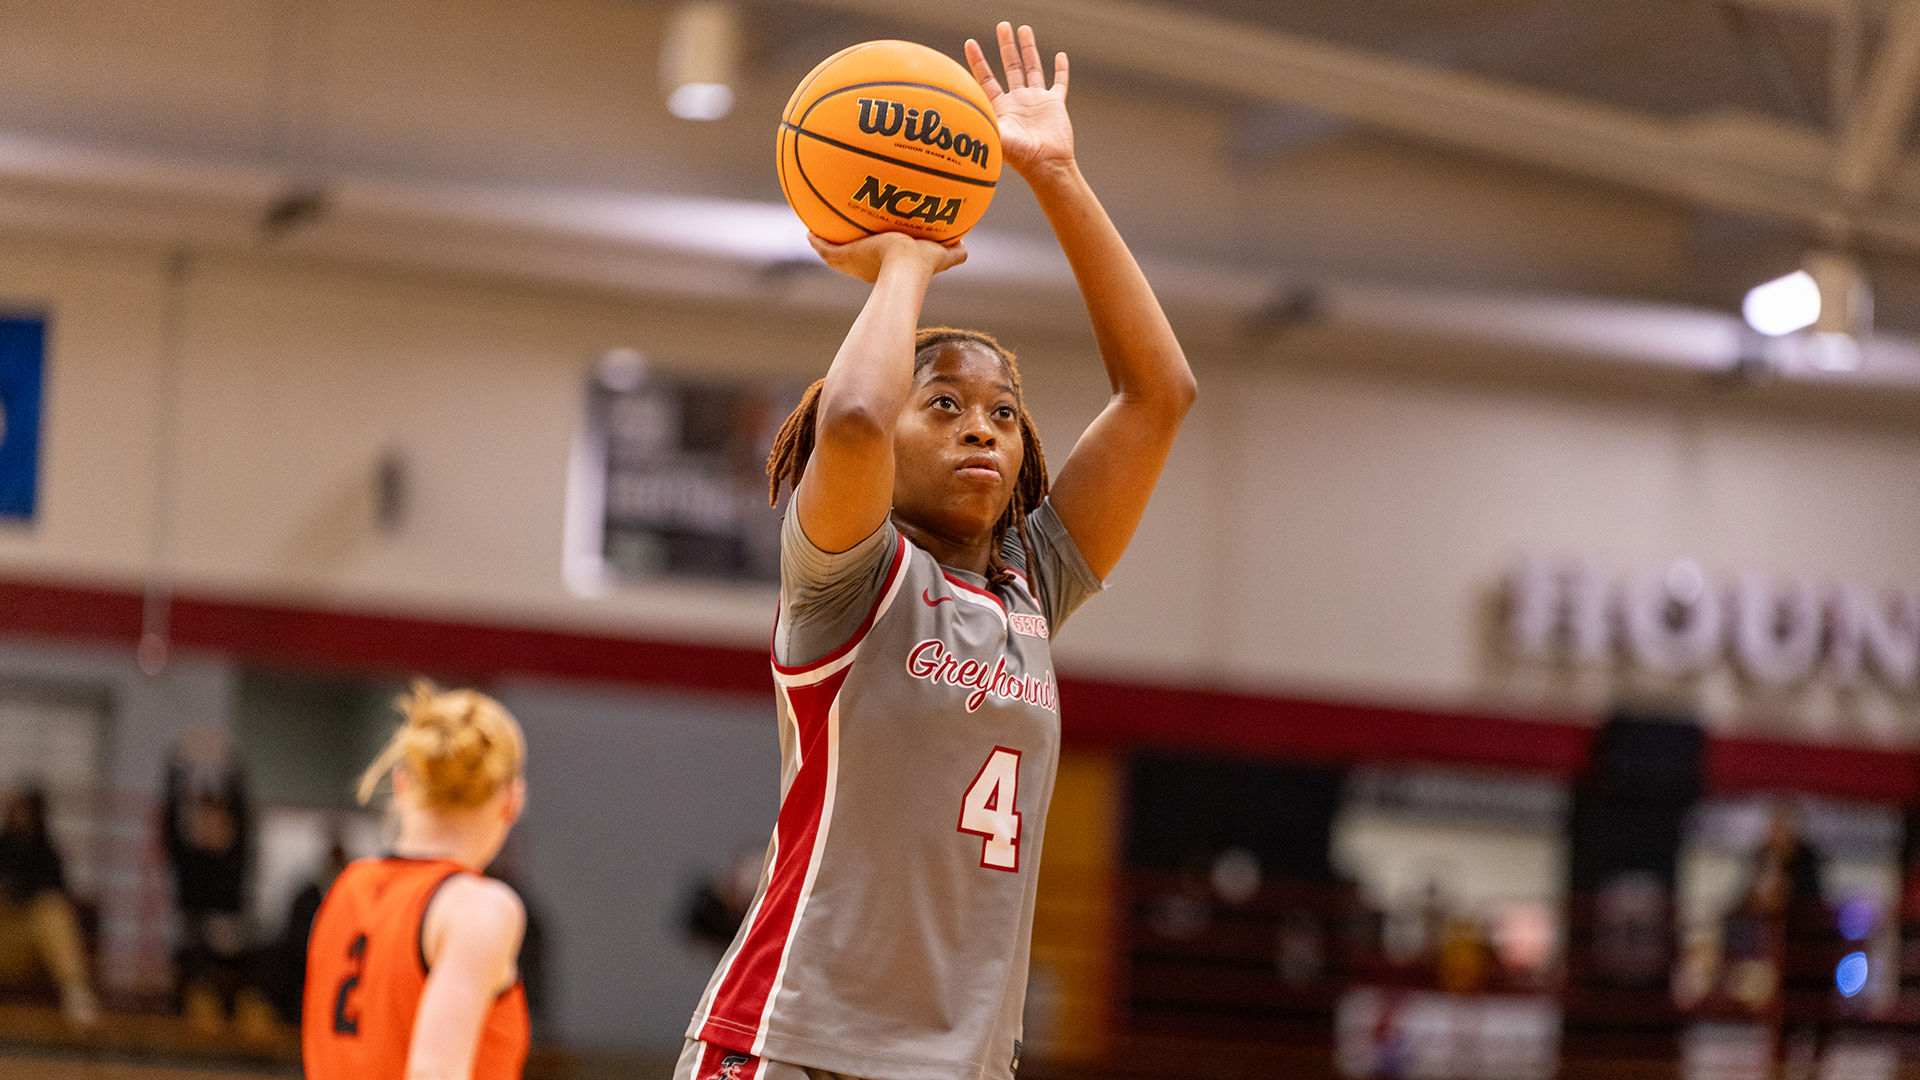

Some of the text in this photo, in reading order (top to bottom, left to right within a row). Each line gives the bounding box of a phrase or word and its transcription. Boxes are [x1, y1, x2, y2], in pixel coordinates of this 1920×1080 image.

[857, 97, 989, 169] Wilson
[893, 142, 923, 153] INDOOR
[850, 174, 963, 226] NCAA
[957, 745, 1022, 873] 4
[333, 934, 367, 1034] 2
